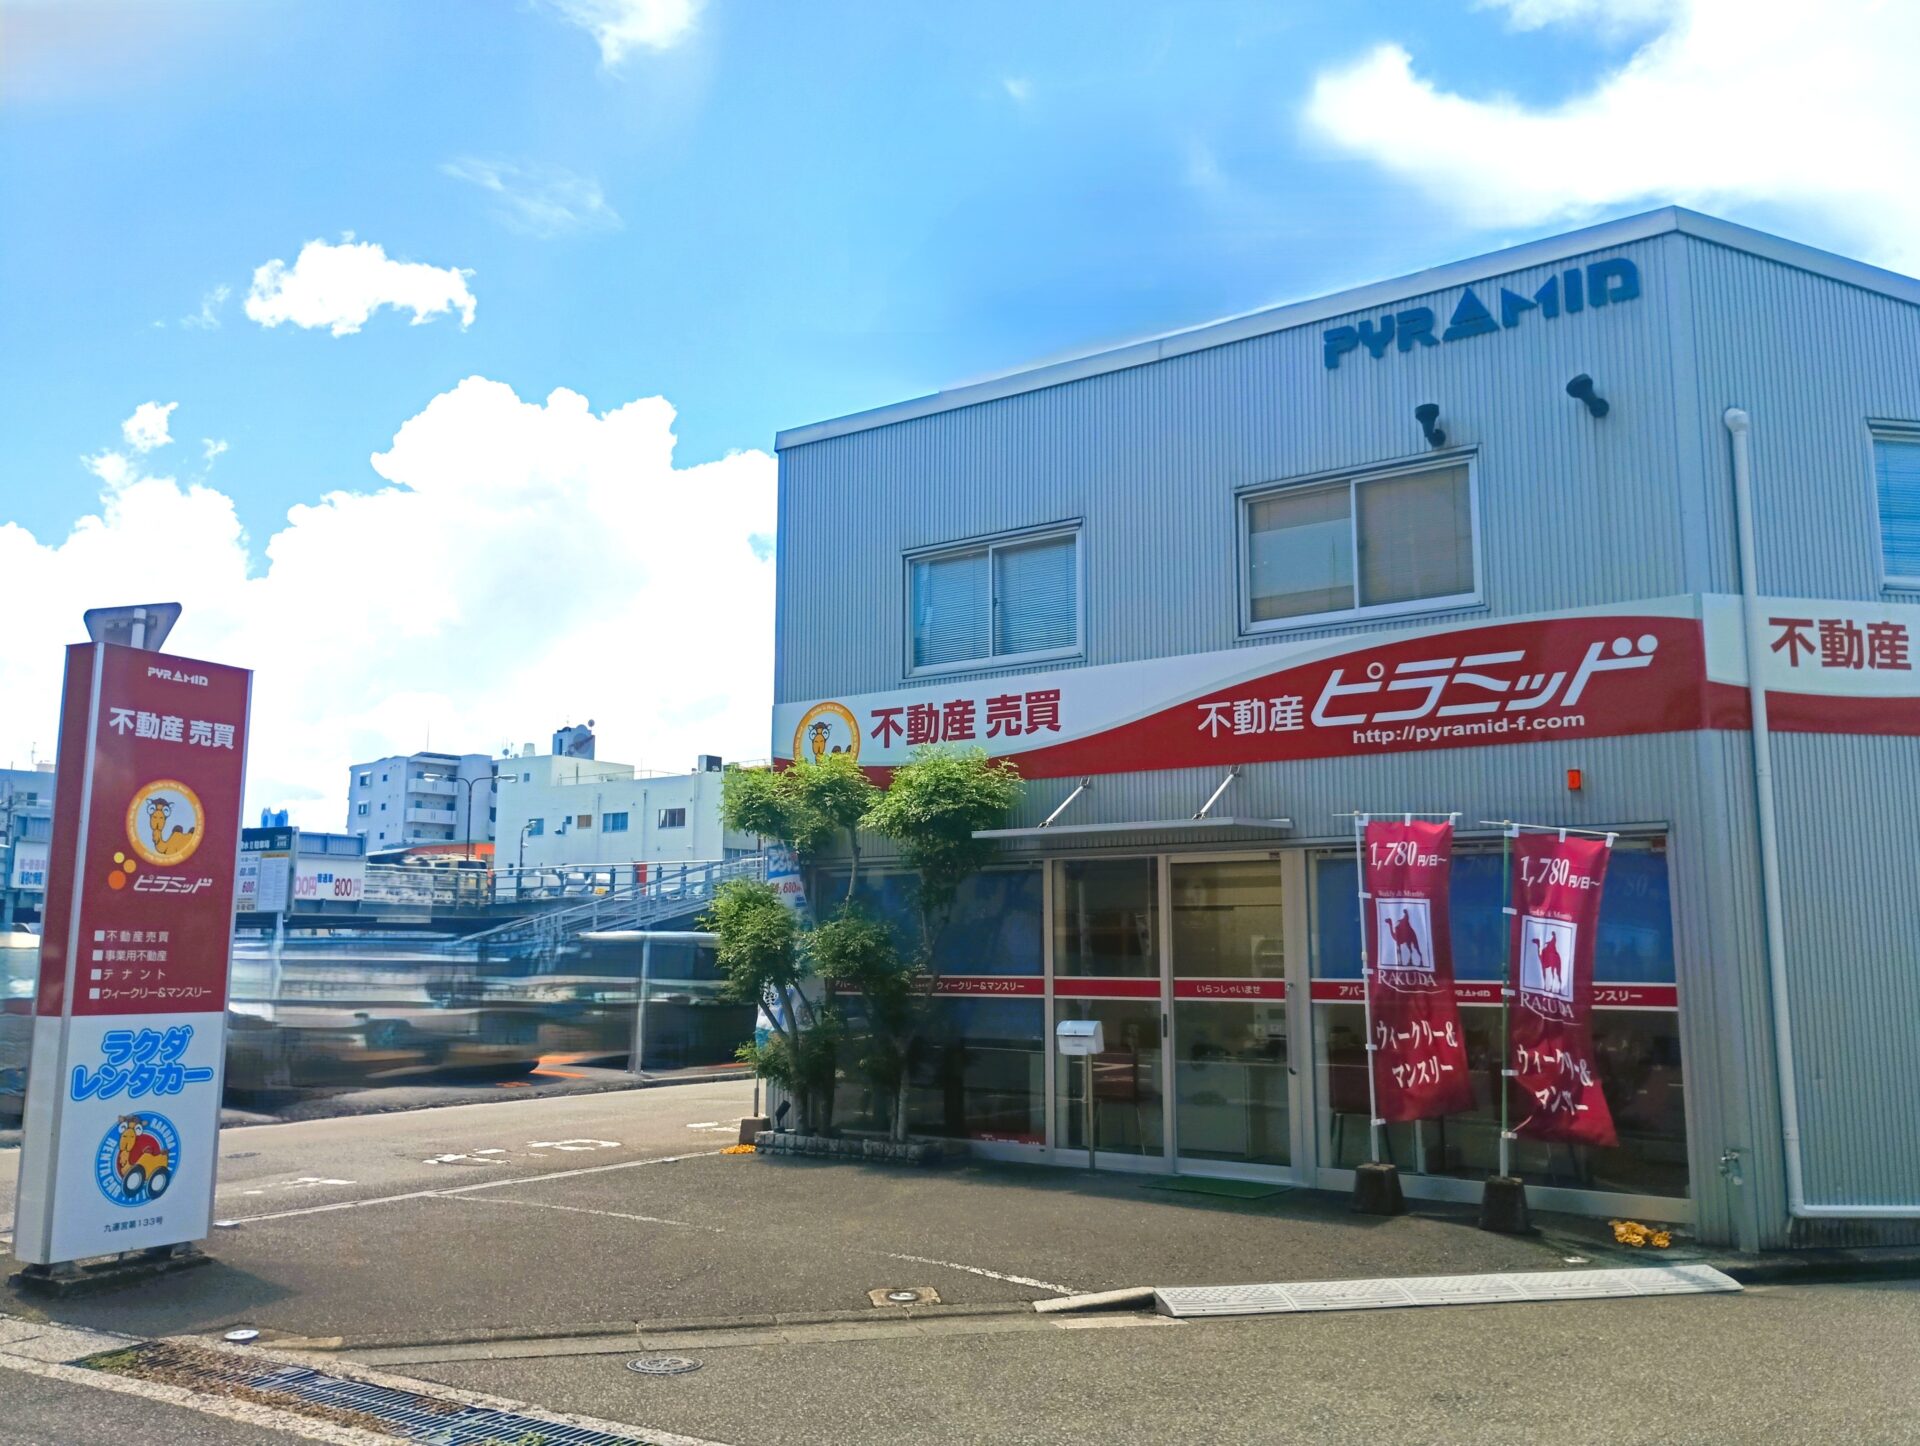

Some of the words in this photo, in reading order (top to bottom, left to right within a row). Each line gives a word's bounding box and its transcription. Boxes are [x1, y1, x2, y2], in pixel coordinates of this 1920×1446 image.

[1323, 257, 1640, 370] PYRAMID
[1768, 616, 1912, 671] 不動産
[147, 666, 209, 687] PYRAMID
[1310, 633, 1659, 729] ピラミッド
[109, 706, 184, 743] 不動産
[188, 719, 236, 750] 売買
[870, 699, 976, 749] 不動産
[986, 689, 1062, 739] 売買
[1197, 695, 1305, 739] 不動産
[1352, 711, 1586, 745] http://pyramid-f.com
[133, 874, 214, 894] ピラミッド
[106, 930, 170, 944] 不動産売買
[104, 949, 168, 962] 事業用不動産
[103, 968, 167, 981] テナント
[1196, 984, 1262, 995] いらっしゃいませ
[1377, 969, 1438, 987] RAKUDA
[101, 1024, 194, 1066] ラクダ
[71, 1062, 214, 1101] レンタカー
[1392, 1055, 1454, 1089] マンスリー
